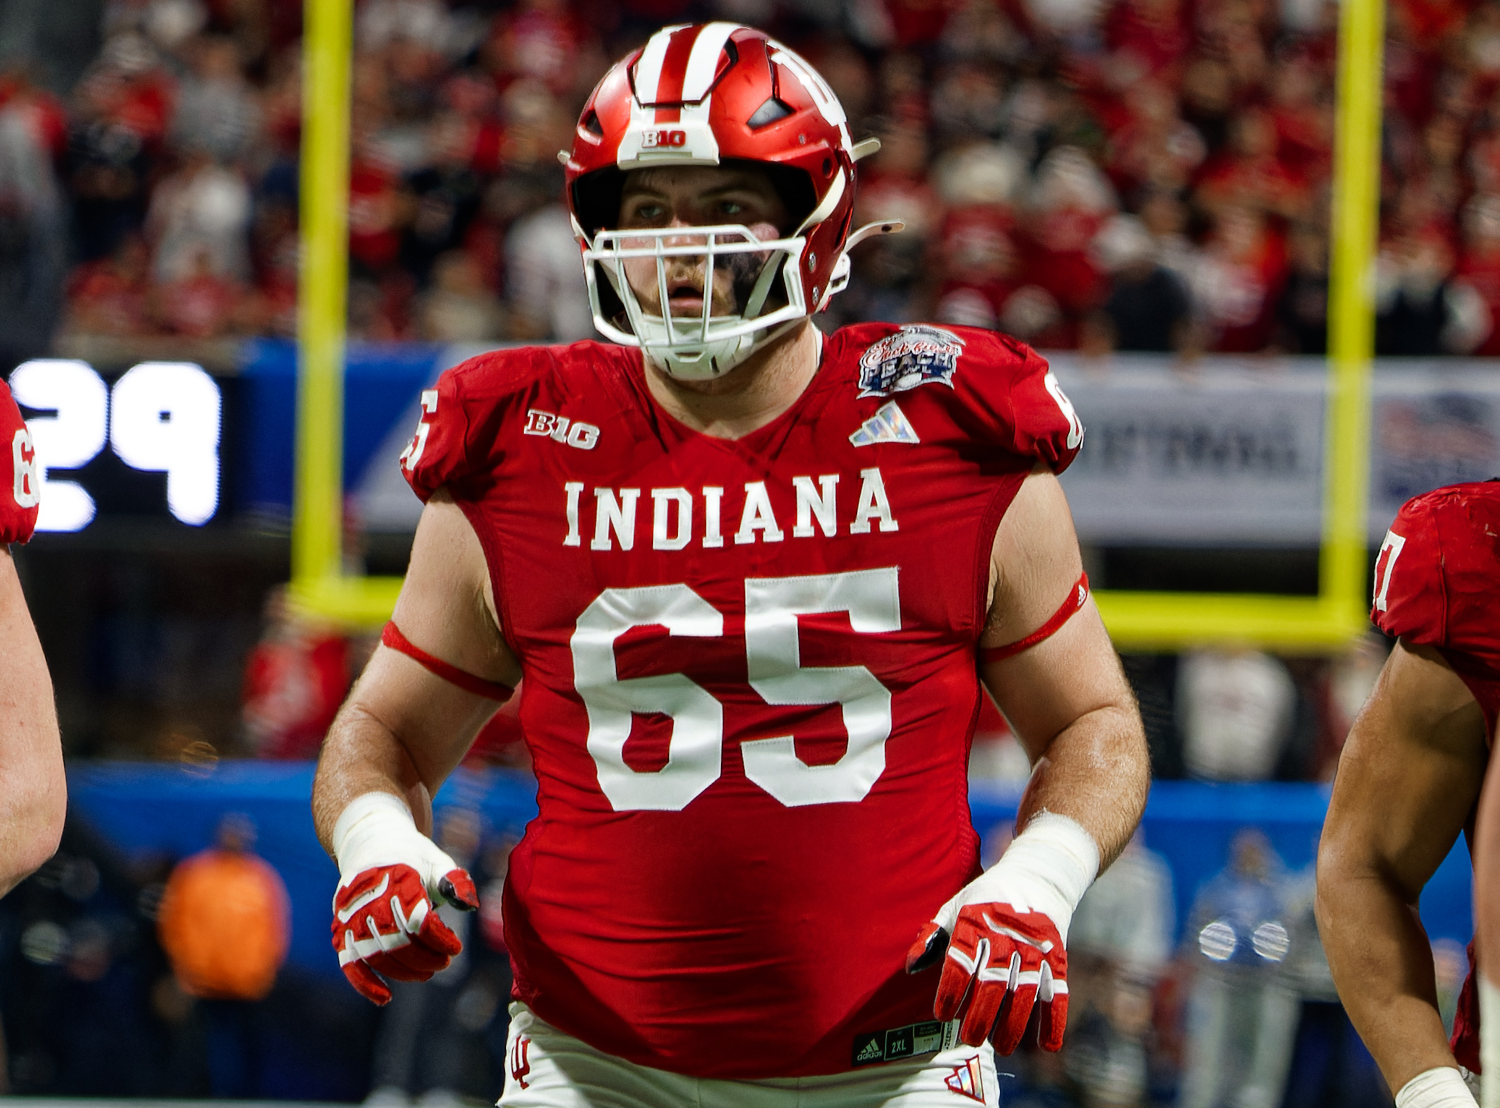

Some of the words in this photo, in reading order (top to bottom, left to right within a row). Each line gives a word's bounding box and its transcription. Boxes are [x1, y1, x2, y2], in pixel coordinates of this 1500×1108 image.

[563, 467, 900, 551] INDIANA
[569, 565, 902, 812] 65
[857, 1049, 883, 1061] adidas
[891, 1038, 907, 1054] 2XL
